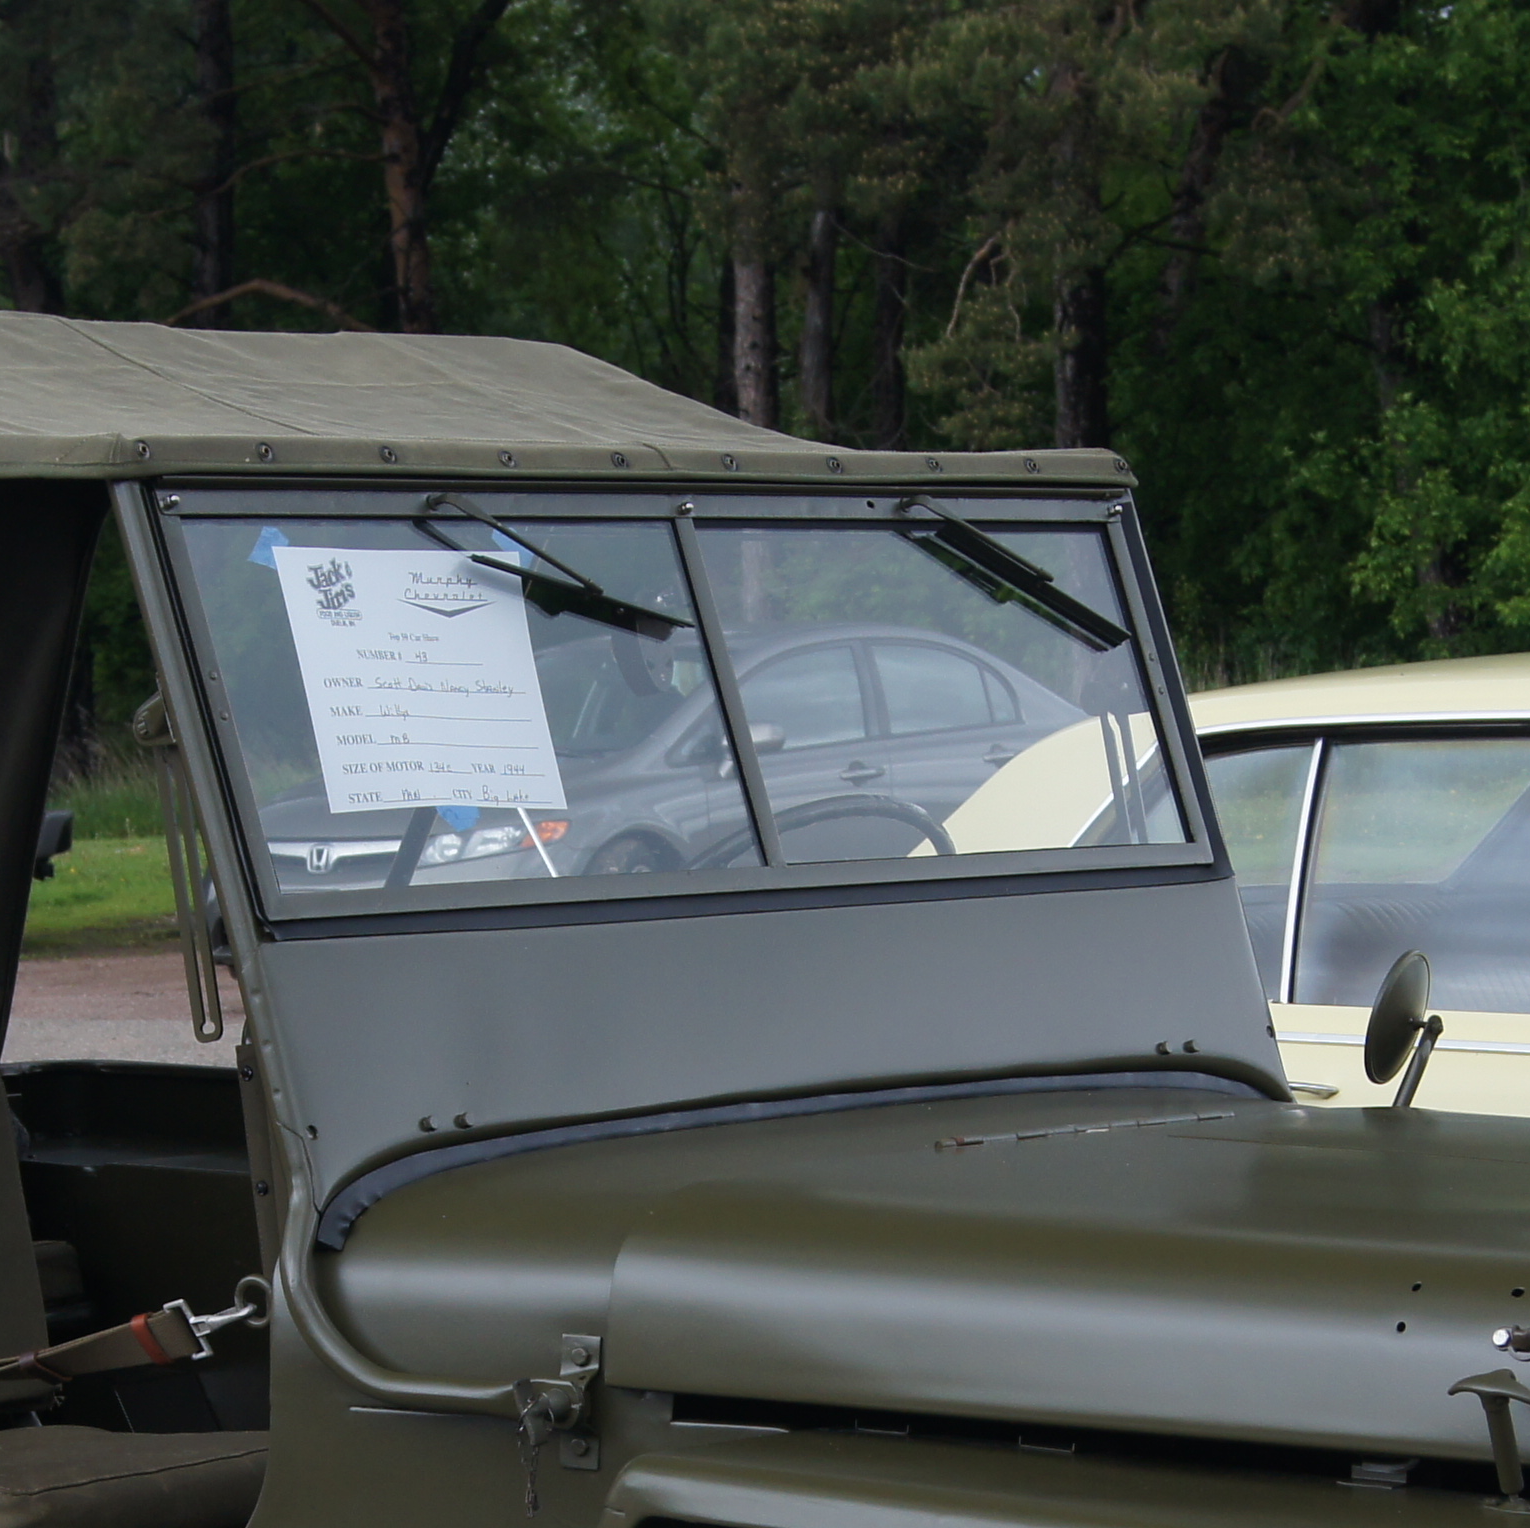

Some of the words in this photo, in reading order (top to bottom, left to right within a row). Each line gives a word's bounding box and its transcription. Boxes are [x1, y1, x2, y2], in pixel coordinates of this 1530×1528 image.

[306, 557, 345, 589] Jack
[408, 571, 478, 588] Murphy
[316, 582, 356, 609] Jim's
[404, 588, 488, 601] Chevrolet
[357, 649, 396, 661] NUMBER
[415, 651, 428, 663] 43
[323, 677, 363, 688] OWNER
[330, 705, 363, 717] MAKE
[336, 734, 377, 745] MODEL
[342, 763, 367, 774] SIZE
[369, 762, 384, 772] OF
[386, 760, 424, 772] MOTOR
[471, 763, 496, 774] YEAR
[502, 763, 525, 775] 1944
[348, 793, 383, 804] STATE
[452, 788, 473, 799] CITY
